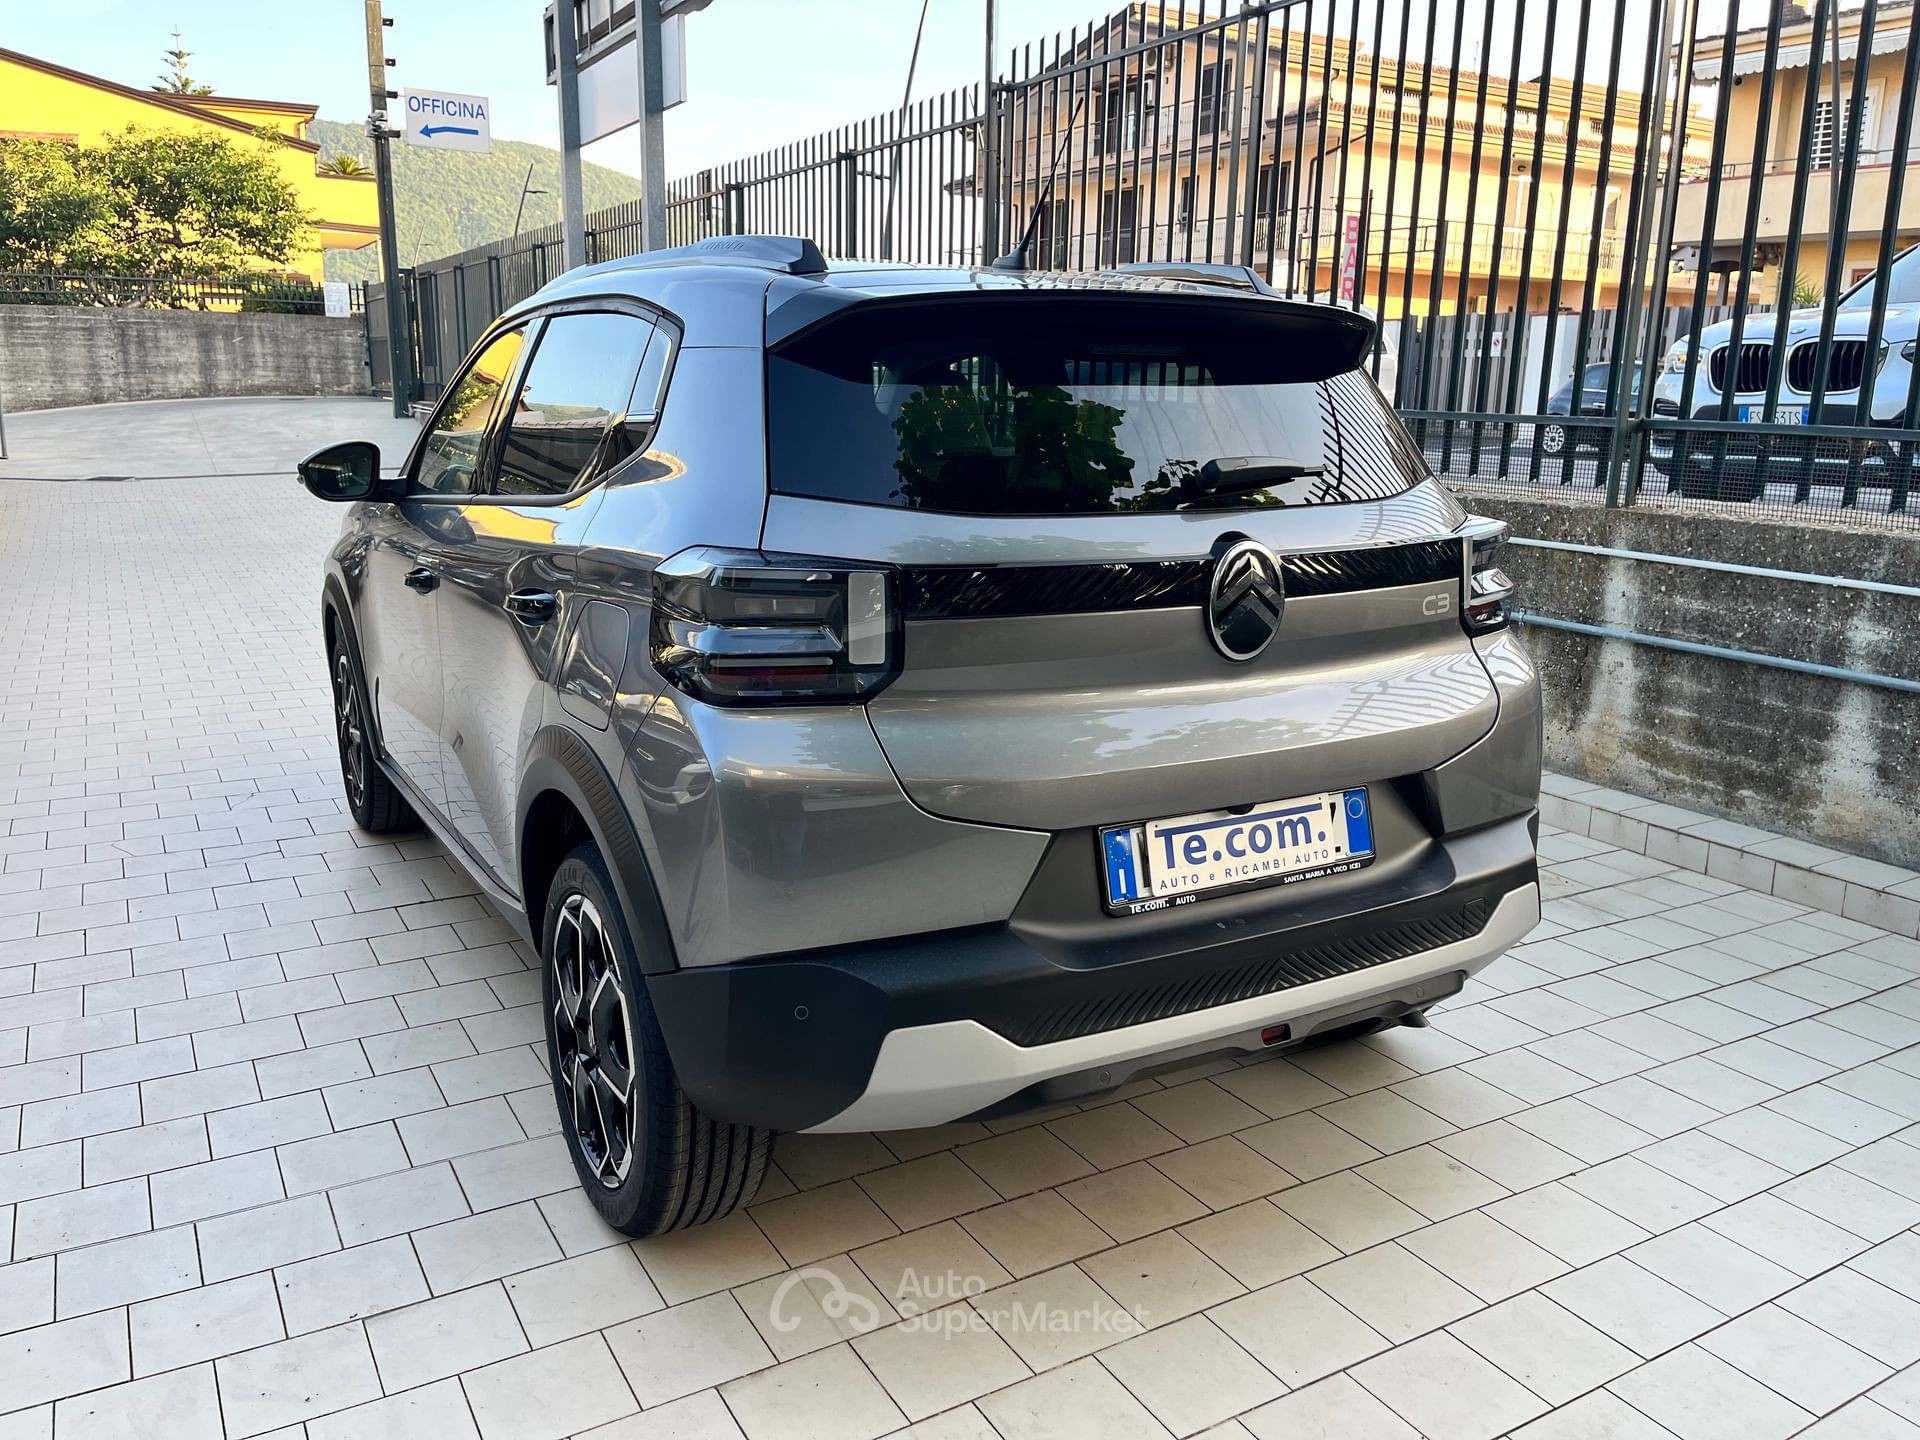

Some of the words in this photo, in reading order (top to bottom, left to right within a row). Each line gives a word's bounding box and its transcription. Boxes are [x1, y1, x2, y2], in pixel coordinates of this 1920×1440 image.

[408, 96, 486, 120] OFFICINA
[1341, 216, 1360, 302] BAR
[1422, 592, 1450, 616] C3
[1154, 802, 1326, 870] Te.com.
[1160, 873, 1200, 890] AUTO
[1209, 873, 1215, 881] e
[1225, 858, 1286, 878] RICAMBI
[1294, 849, 1329, 864] AUTO
[1283, 873, 1304, 884] SANTA
[1305, 869, 1325, 879] MARIA
[1333, 865, 1348, 874] VICO
[1129, 898, 1170, 914] Te.com.
[1175, 894, 1196, 906] AUTO
